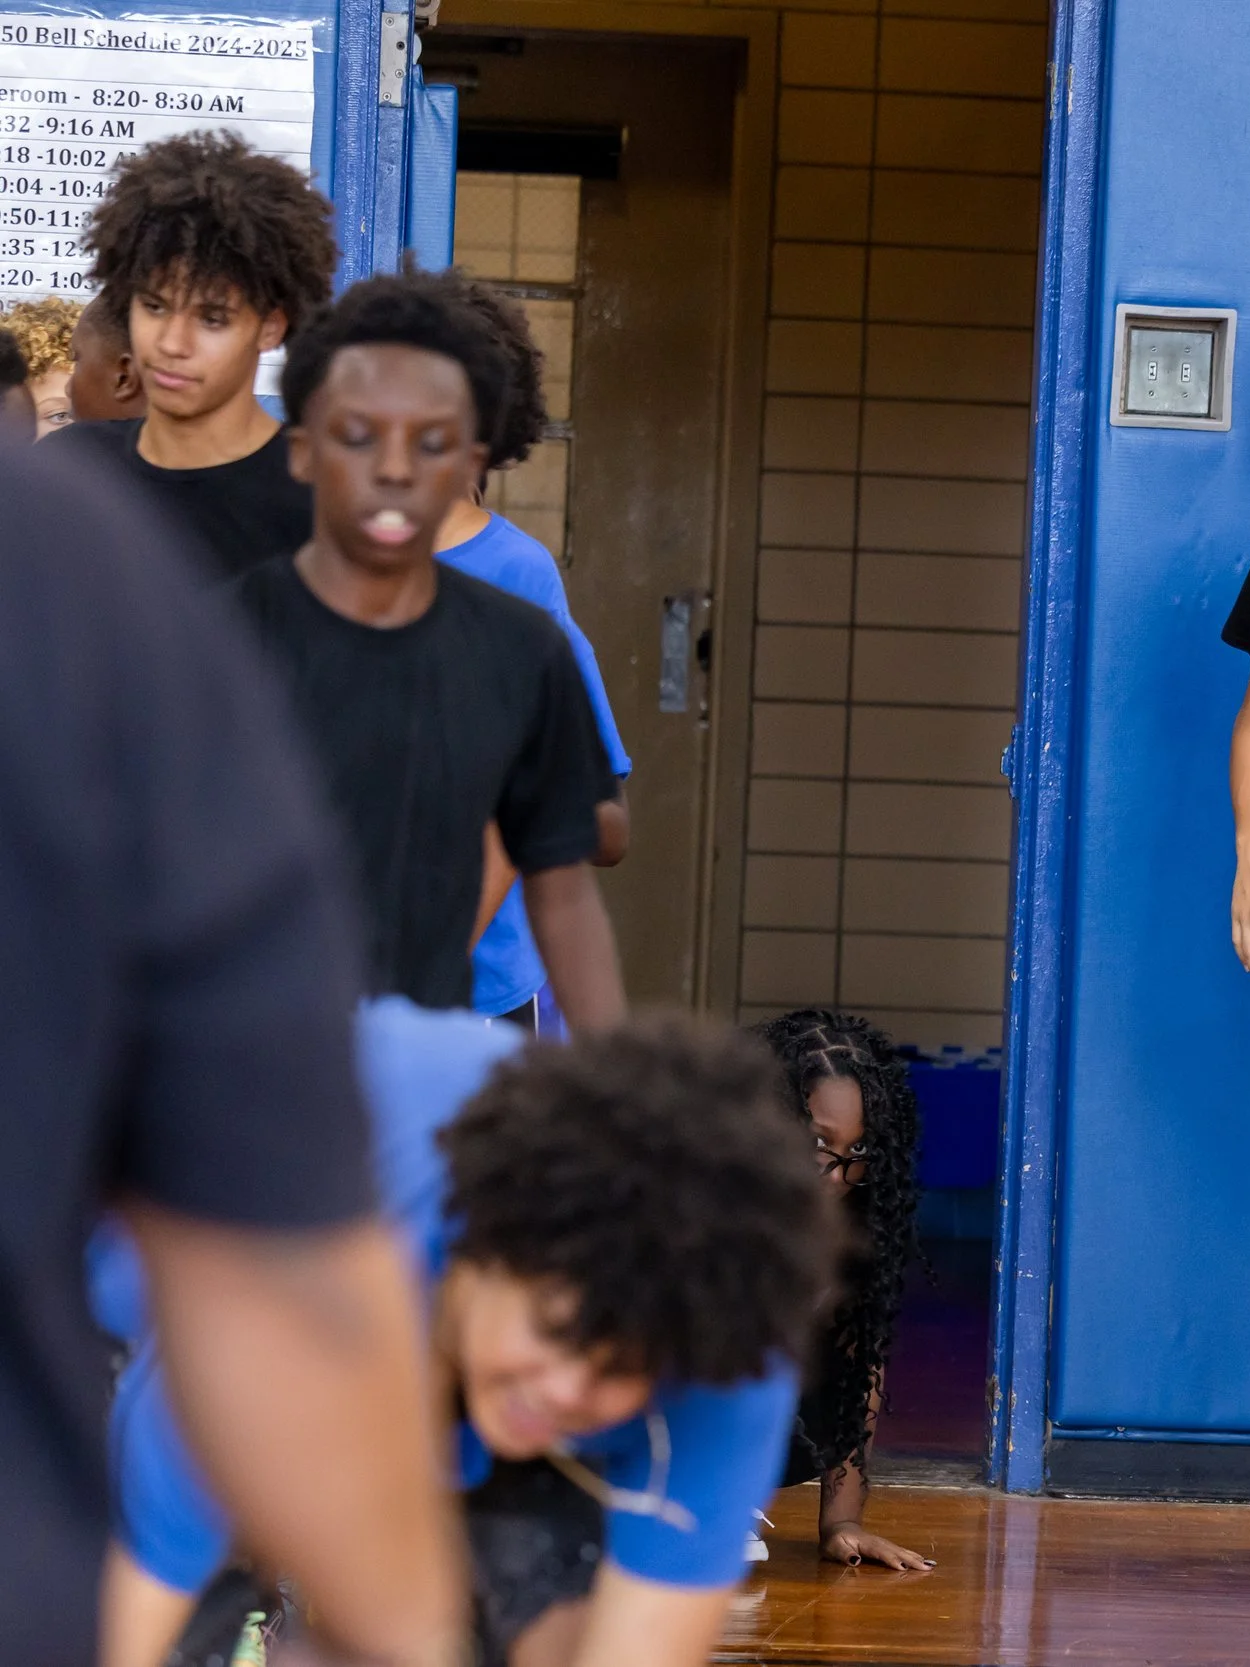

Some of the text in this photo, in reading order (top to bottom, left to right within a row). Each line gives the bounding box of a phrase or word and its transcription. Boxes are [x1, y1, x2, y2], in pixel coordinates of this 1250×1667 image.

[2, 25, 28, 43] 50
[35, 27, 77, 46] Bell
[188, 35, 308, 58] 2024-2025
[155, 92, 203, 111] 8:30
[209, 95, 244, 113] AM
[99, 120, 135, 139] AM
[0, 146, 30, 164] 18
